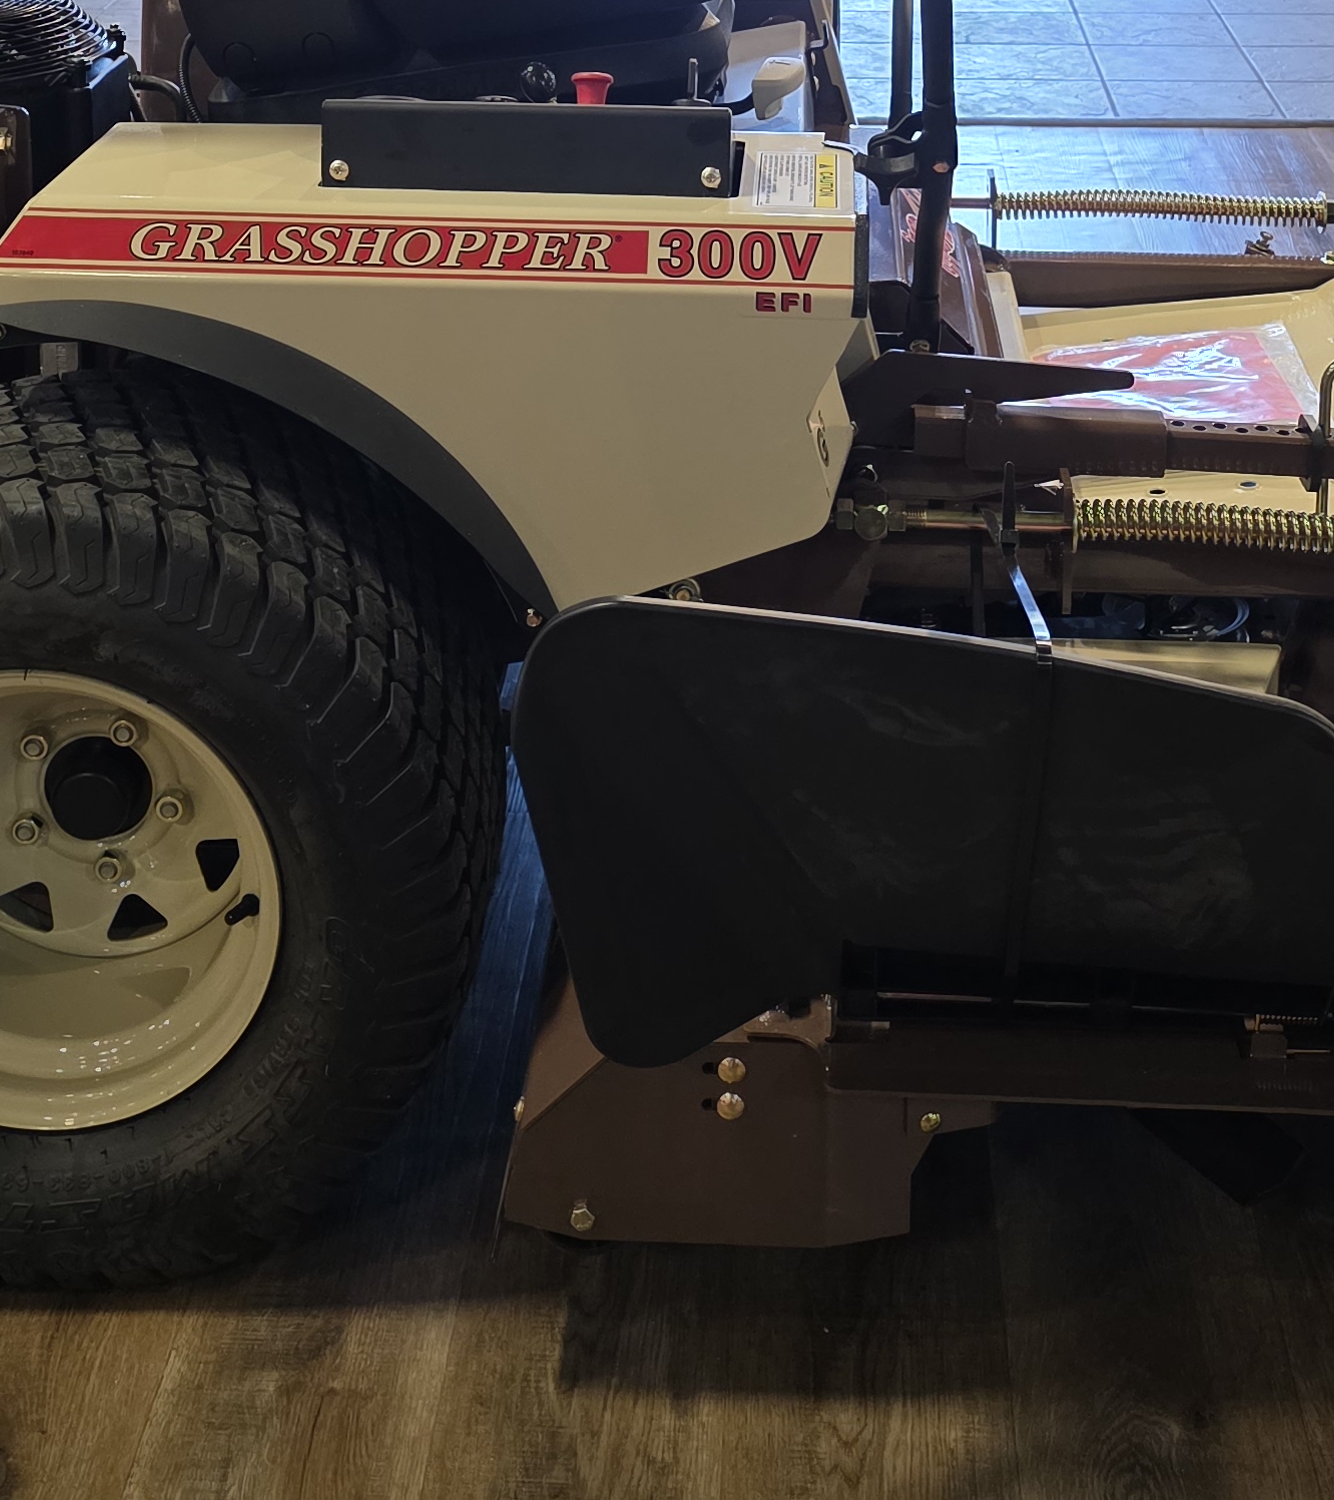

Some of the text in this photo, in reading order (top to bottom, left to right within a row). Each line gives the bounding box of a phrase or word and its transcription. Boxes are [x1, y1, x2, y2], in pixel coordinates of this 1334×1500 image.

[819, 170, 835, 198] CAUTION
[128, 221, 823, 280] GRASSHOPPER 300V
[755, 291, 812, 314] EFI
